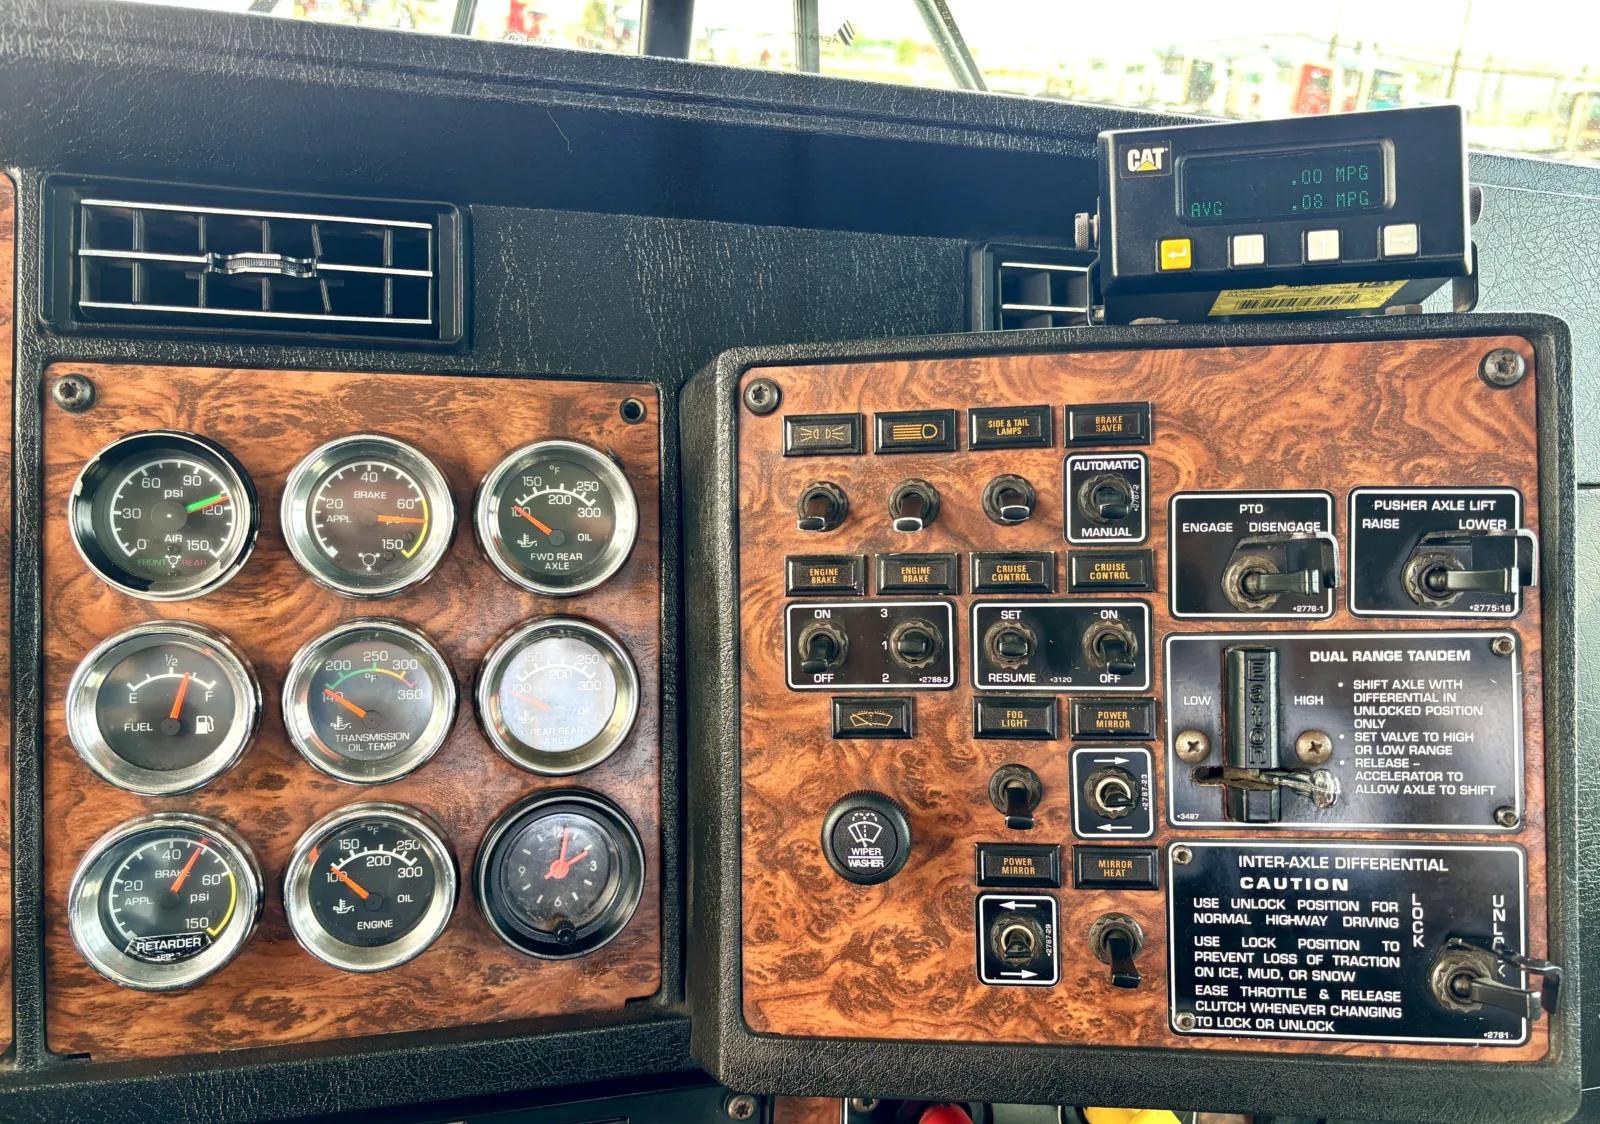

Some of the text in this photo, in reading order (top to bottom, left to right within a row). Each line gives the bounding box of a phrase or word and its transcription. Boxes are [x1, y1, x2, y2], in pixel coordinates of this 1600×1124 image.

[1127, 147, 1165, 172] CAT
[1336, 165, 1369, 182] MPG
[1191, 201, 1224, 217] AVG
[1336, 190, 1369, 208] MPG
[1014, 418, 1029, 427] TAIL
[1096, 416, 1123, 424] BRAKE
[997, 427, 1021, 435] LAMPS
[1096, 424, 1122, 432] SAVER
[1074, 461, 1139, 471] AUTOMATIC
[183, 476, 201, 486] 90
[361, 472, 378, 482] 40
[522, 477, 542, 486] 150
[142, 478, 160, 488] 60
[576, 482, 599, 491] 250
[164, 488, 183, 499] psi
[326, 499, 343, 508] 20
[397, 499, 414, 509] 60
[548, 495, 571, 504] 200
[1240, 504, 1263, 514] PTO
[1374, 500, 1496, 511] PUSHER AXLE LIFT
[122, 508, 141, 518] 30
[578, 508, 601, 518] 300
[1182, 523, 1232, 532] ENGAGE
[1249, 522, 1321, 532] DISENGAGE
[1362, 519, 1399, 529] RAISE
[1459, 519, 1507, 530] LOWER
[1082, 528, 1132, 537] MANUAL
[187, 540, 209, 550] 150
[382, 539, 403, 549] 150
[810, 568, 839, 576] ENGINE
[997, 565, 1027, 573] CRUISE
[812, 576, 836, 584] BRAKE
[1090, 572, 1130, 580] CONTROL
[814, 610, 831, 619] ON
[880, 609, 888, 618] 3
[1001, 611, 1021, 619] SET
[1101, 610, 1118, 619] ON
[363, 651, 388, 661] 250
[1310, 650, 1470, 662] DUAL RANGE TANDEM
[325, 661, 351, 671] 200
[393, 660, 418, 669] 300
[814, 674, 834, 683] OFF
[882, 674, 889, 682] 2
[988, 674, 1036, 682] RESUME
[1100, 674, 1121, 683] OFF
[1354, 680, 1462, 689] SHIFT AXLE WITH
[398, 690, 422, 700] 360
[1354, 693, 1456, 703] DIFFERENTIAL IN
[1184, 696, 1211, 705] LOW
[1294, 696, 1324, 705] HIGH
[1354, 706, 1483, 716] UNLOCKED POSITION
[124, 723, 153, 732] FUEL
[1002, 719, 1028, 727] LIGHT
[1096, 720, 1130, 728] MIRROR
[1354, 719, 1386, 728] ONLY
[336, 733, 409, 742] TRANSMISSION
[1355, 732, 1474, 742] SET VALVE TO HIGH
[368, 742, 396, 750] TEMP
[1355, 745, 1453, 755] OR LOW RANGE
[1355, 758, 1409, 768] RELEASE
[1355, 771, 1463, 781] ACCELERATOR TO
[1355, 785, 1496, 795] ALLOW AXLE TO SHIFT
[339, 839, 359, 849] 150
[396, 840, 420, 850] 250
[162, 850, 181, 860] 40
[851, 848, 881, 856] WIPER
[367, 856, 391, 867] 200
[1004, 858, 1032, 866] POWER
[1099, 860, 1132, 868] MIRROR
[1238, 856, 1448, 871] INTER-AXLE DIFFERENTIAL
[398, 867, 422, 878] 300
[1002, 866, 1035, 875] MIRROR
[1104, 869, 1125, 877] HEAT
[202, 875, 221, 885] 60
[1240, 877, 1348, 891] CAUTION
[124, 881, 142, 891] 20
[190, 891, 209, 903] psi
[398, 895, 413, 903] OIL
[1193, 898, 1398, 912] USE UNLOCK POSITION FOR
[186, 918, 208, 928] 150
[357, 920, 393, 929] ENGINE
[1194, 913, 1399, 928] NORMAL HIGHWAY DRIVING
[1411, 893, 1424, 948] LOCK
[137, 938, 201, 951] RETARDER
[1194, 936, 1400, 951] USE LOCK POSITION TO
[1195, 952, 1400, 967] PREVENT LOSS OF TRACTION
[1195, 967, 1356, 982] ON ICE, MUD, OR SNOW
[1195, 985, 1401, 1002] EASE THROTTLE & RELEASE
[1196, 1001, 1402, 1018] CLUTCH WHENEVER CHANGING
[1196, 1016, 1335, 1032] TO LOCK OR UNLOCK
